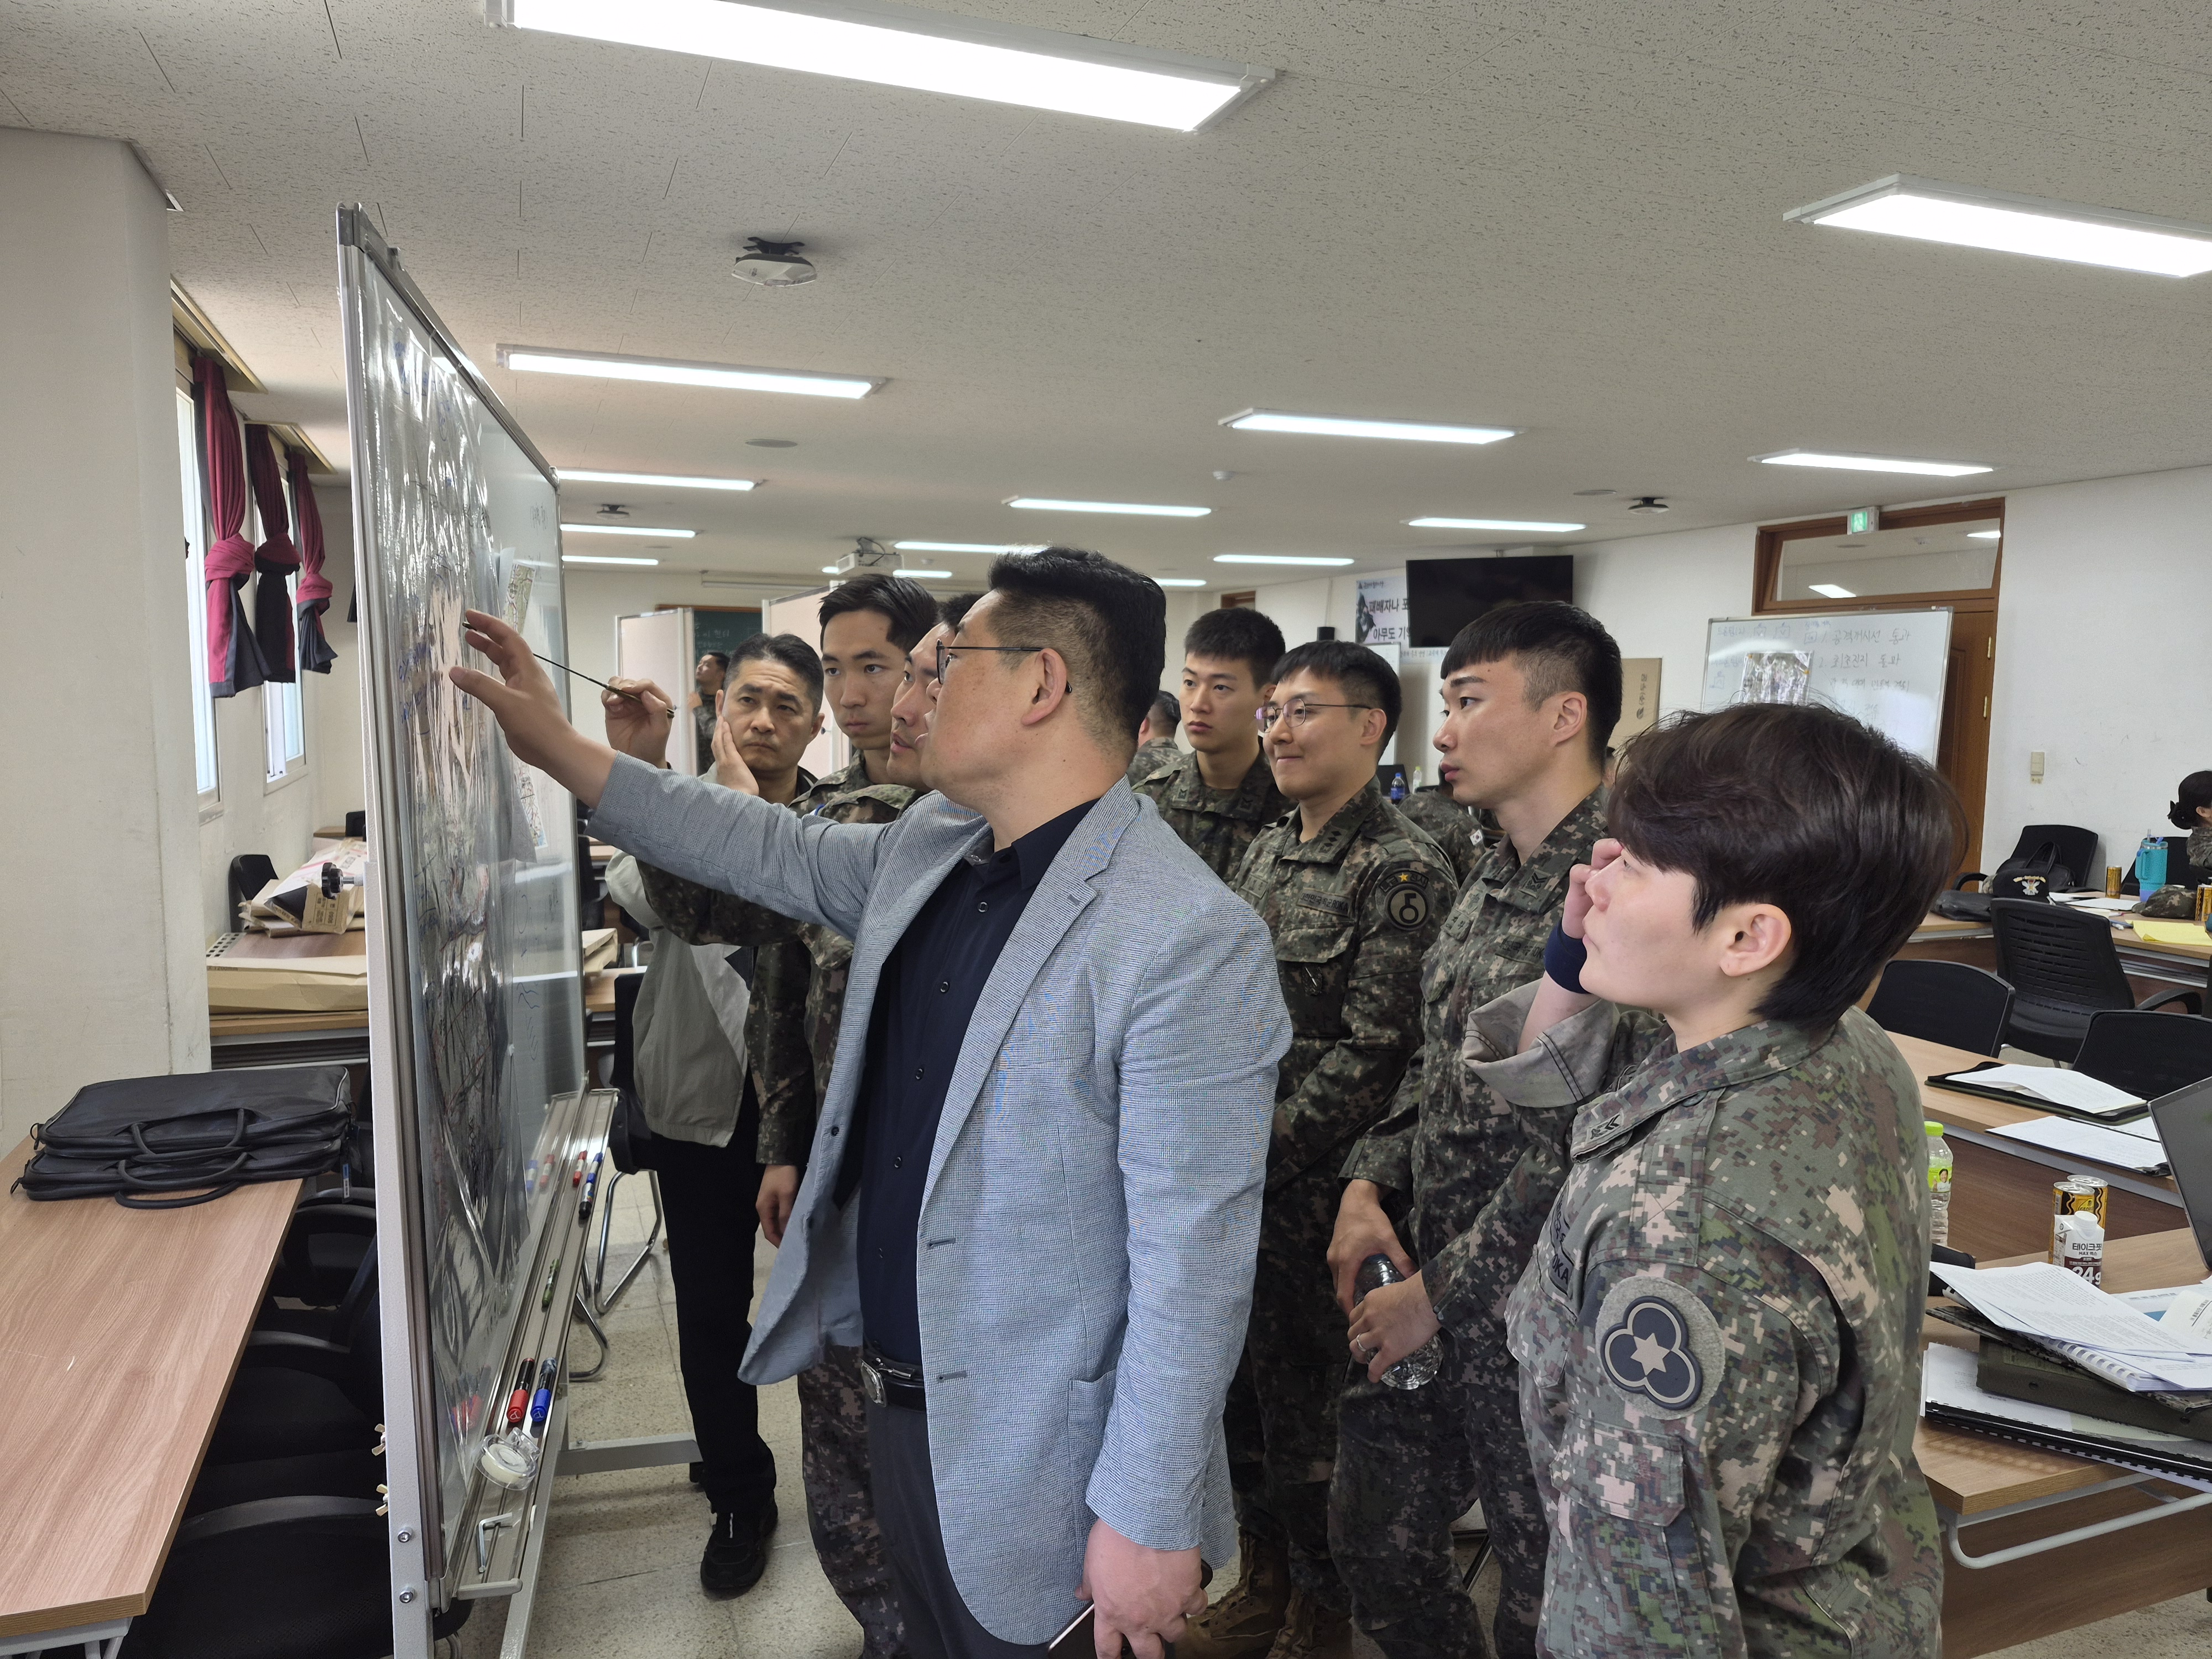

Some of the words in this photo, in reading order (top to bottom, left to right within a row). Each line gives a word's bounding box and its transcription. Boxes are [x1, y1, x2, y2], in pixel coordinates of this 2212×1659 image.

[1368, 598, 1400, 614] 패배자나
[1373, 627, 1395, 641] 아무도
[1300, 893, 1322, 905] 대한민국
[1331, 900, 1348, 911] ROKA
[1551, 1254, 1569, 1284] OKA
